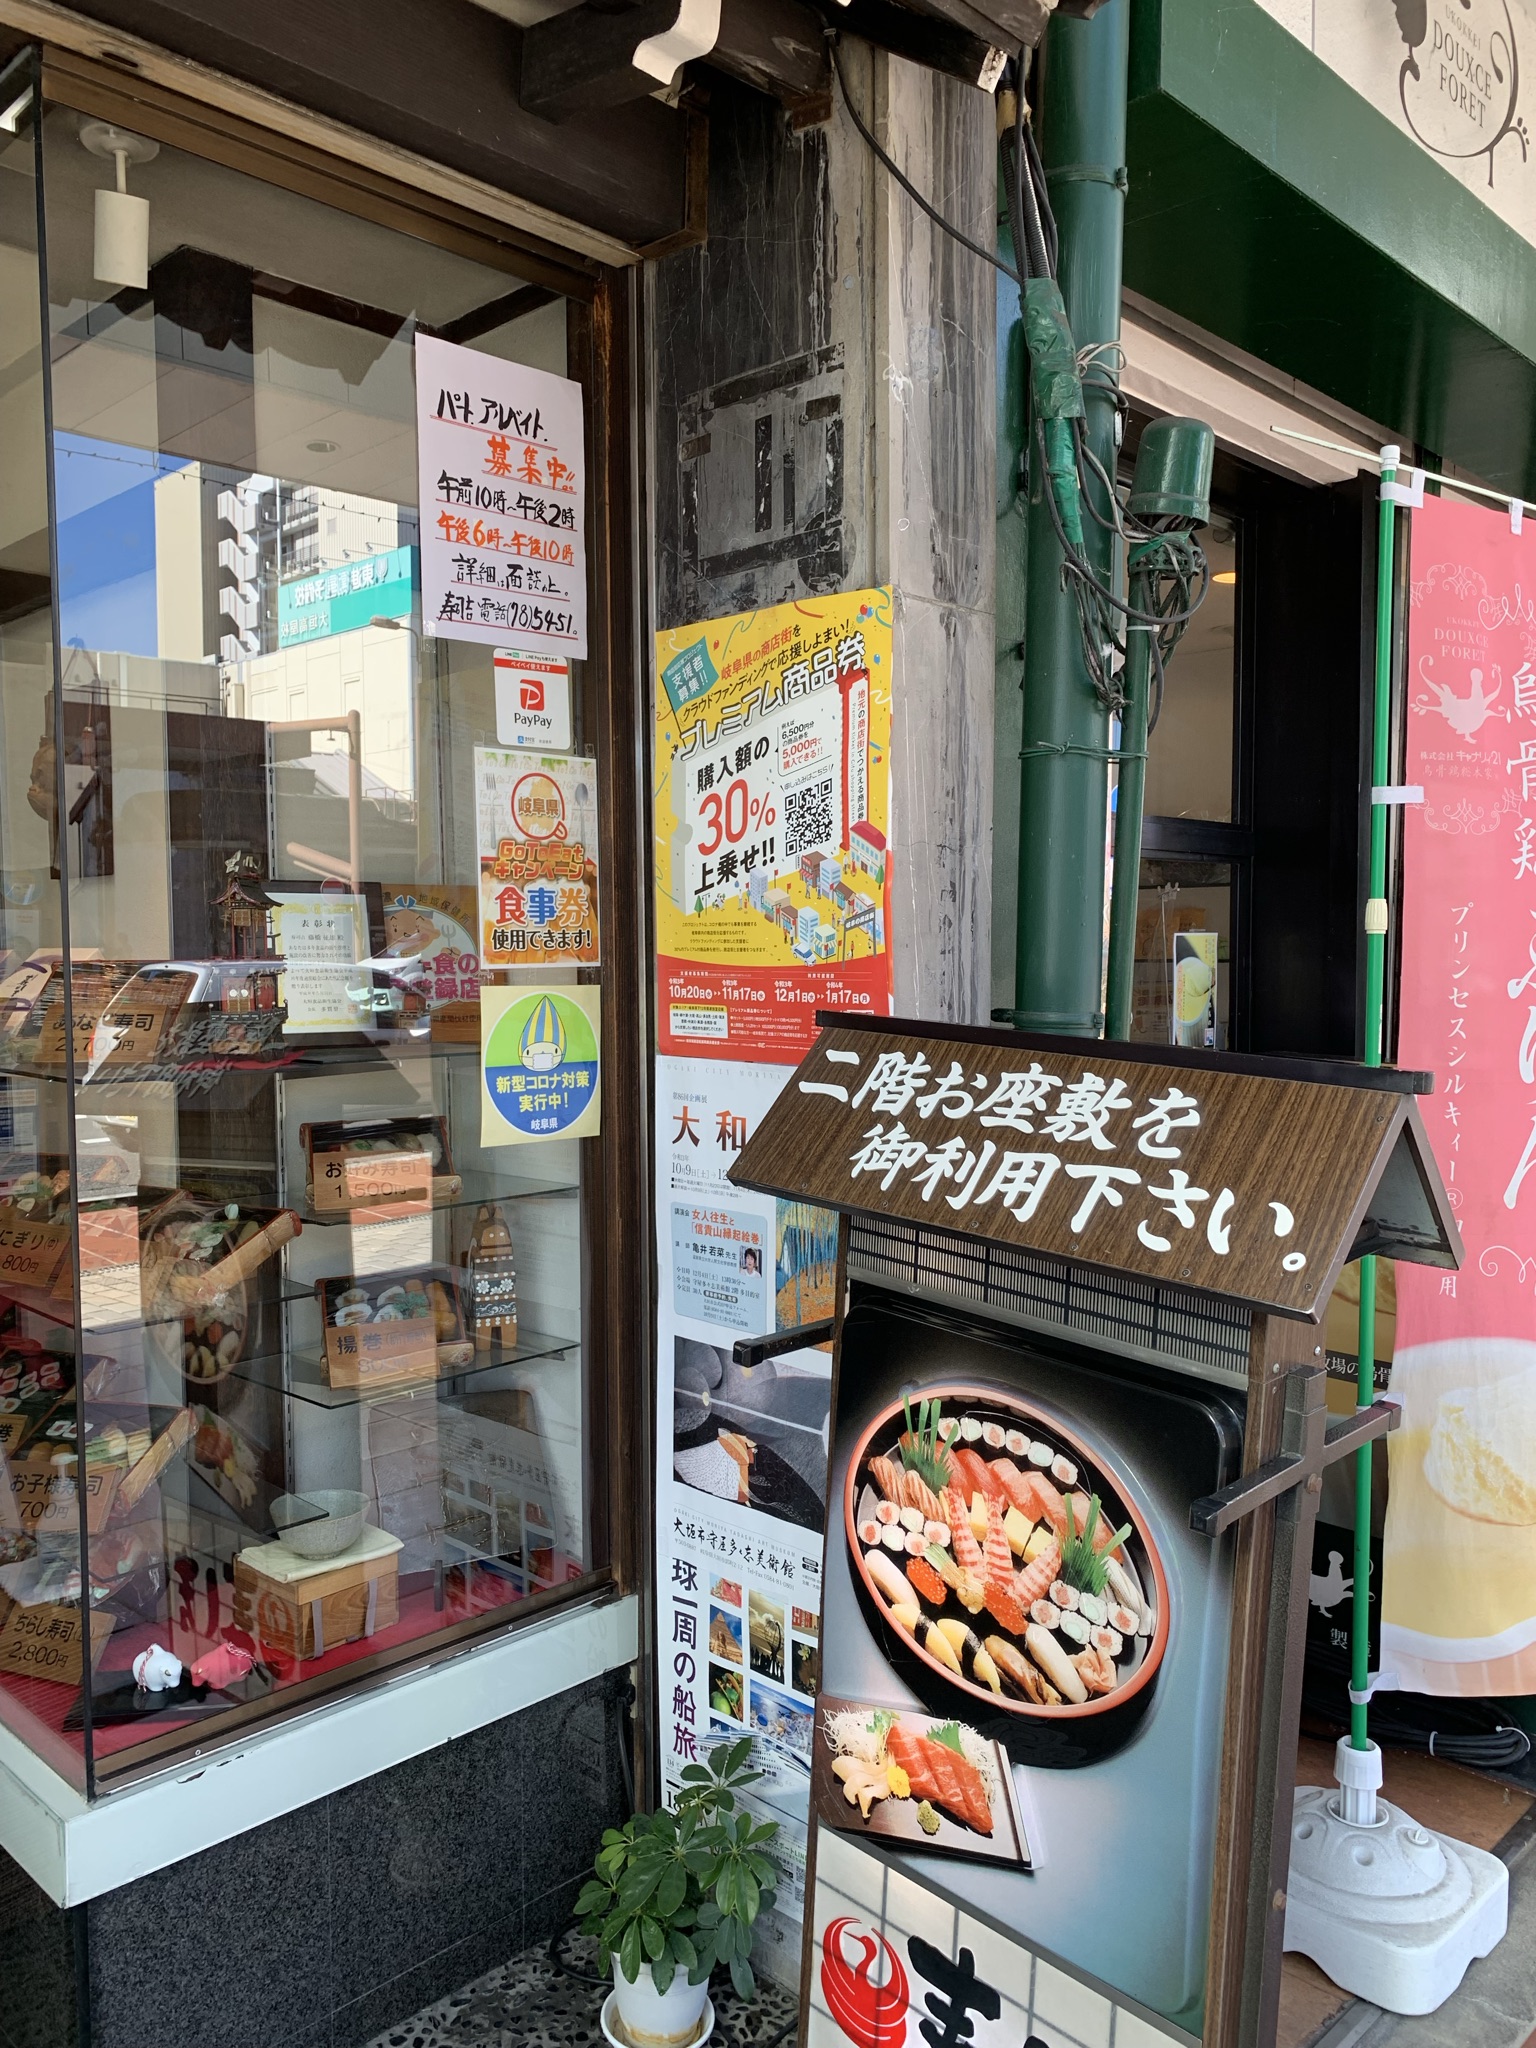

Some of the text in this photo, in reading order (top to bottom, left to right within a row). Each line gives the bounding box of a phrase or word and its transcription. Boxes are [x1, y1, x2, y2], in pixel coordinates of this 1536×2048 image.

[1445, 4, 1480, 50] UKOKKEI
[1433, 19, 1492, 100] DOUXCE
[1440, 63, 1485, 128] FORET
[1434, 628, 1489, 649] DOUXCE
[721, 624, 802, 681] 岐阜県の商店街を
[1441, 645, 1486, 662] FORET
[511, 661, 551, 672] ペイペイ使えます
[672, 655, 704, 689] 支援者
[680, 632, 867, 761] プレミアム商品券
[514, 712, 553, 729] PayPay
[781, 721, 815, 739] 6,500円分
[782, 737, 822, 759] 5,000円で
[1420, 751, 1454, 761] 株式会社
[697, 736, 769, 794] 購入額の
[517, 796, 559, 818] 岐阜県
[698, 779, 776, 856] 30%
[494, 861, 584, 880] キャンペーン
[694, 837, 775, 895] 上乗せ!!
[494, 886, 588, 926] 食事券
[301, 919, 336, 929] 表彰状
[492, 929, 592, 950] 使用できます!
[496, 1071, 590, 1094] 新型コロナ対策
[519, 1094, 568, 1113] 実行中!
[799, 1047, 1200, 1159] 二階お座敷を
[531, 1117, 558, 1130] 岐阜県
[672, 1105, 746, 1152] 大和
[850, 1122, 1307, 1272] 御利用下さい。
[674, 1208, 734, 1226] 講演会 女人往生と
[691, 1221, 763, 1246] 「信貴山縁起絵巻」
[19, 1501, 69, 1519] 700円
[8, 1641, 69, 1668] 2,800円
[671, 1557, 699, 1762] 球一周の船旅
